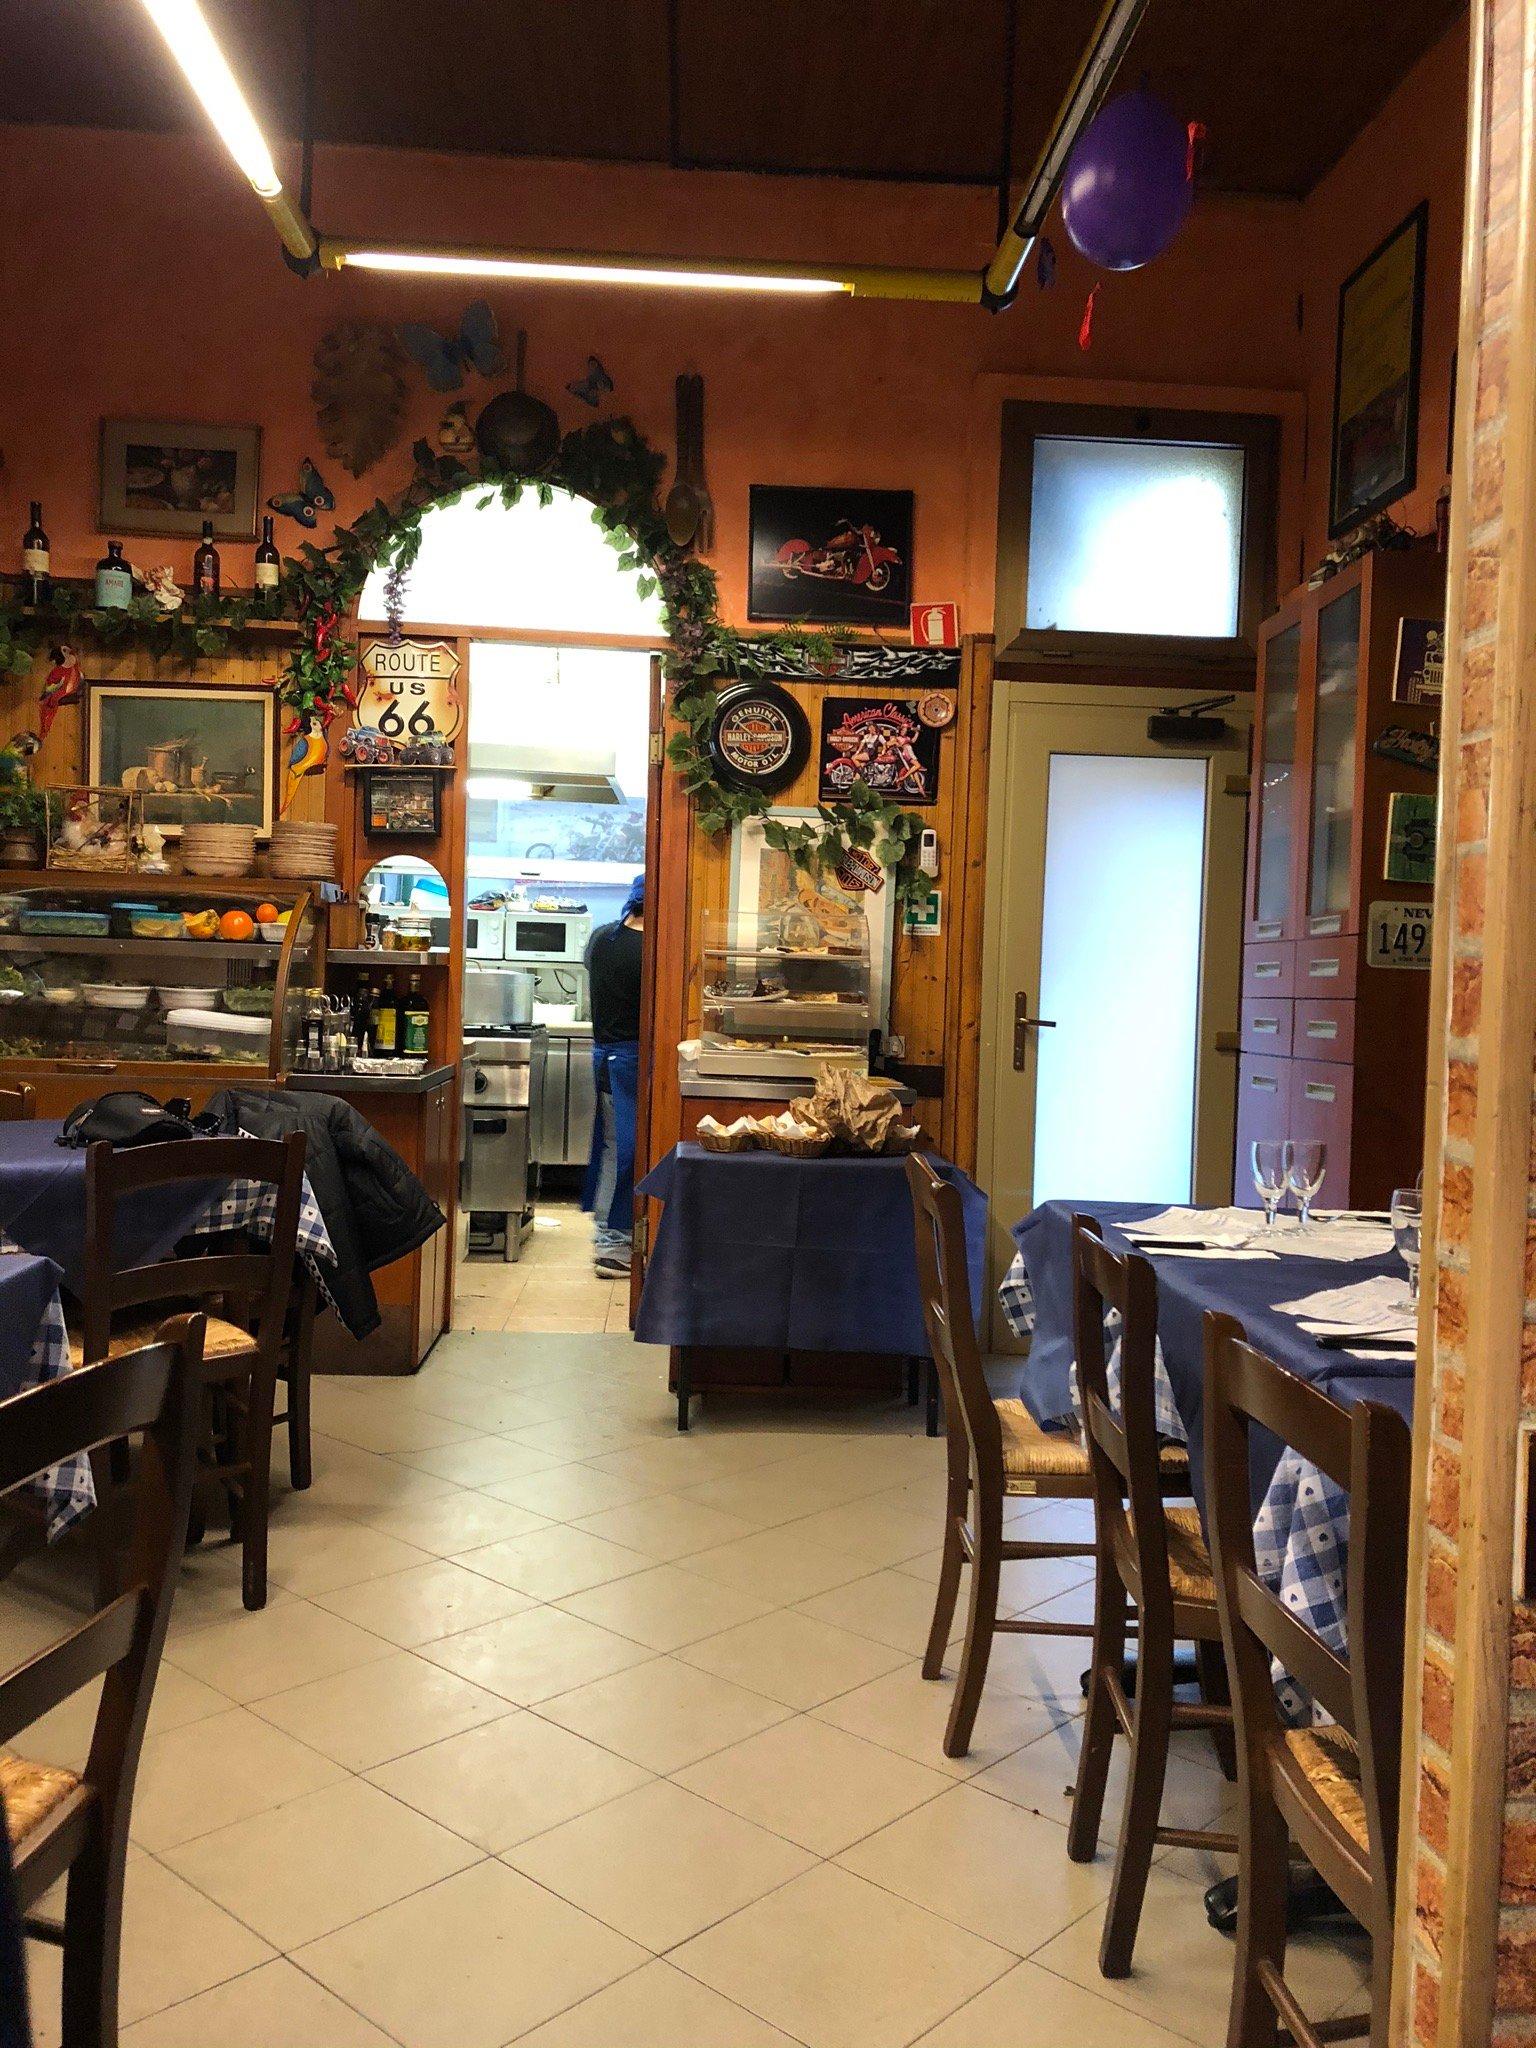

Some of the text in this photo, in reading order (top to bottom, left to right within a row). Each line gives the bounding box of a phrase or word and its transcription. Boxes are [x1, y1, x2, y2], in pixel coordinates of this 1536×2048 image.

[375, 653, 441, 672] ROUTE
[390, 682, 426, 696] US
[378, 699, 435, 737] 66
[731, 706, 779, 723] GENUINE
[842, 708, 882, 727] American
[730, 751, 779, 768] MOTOR OIL
